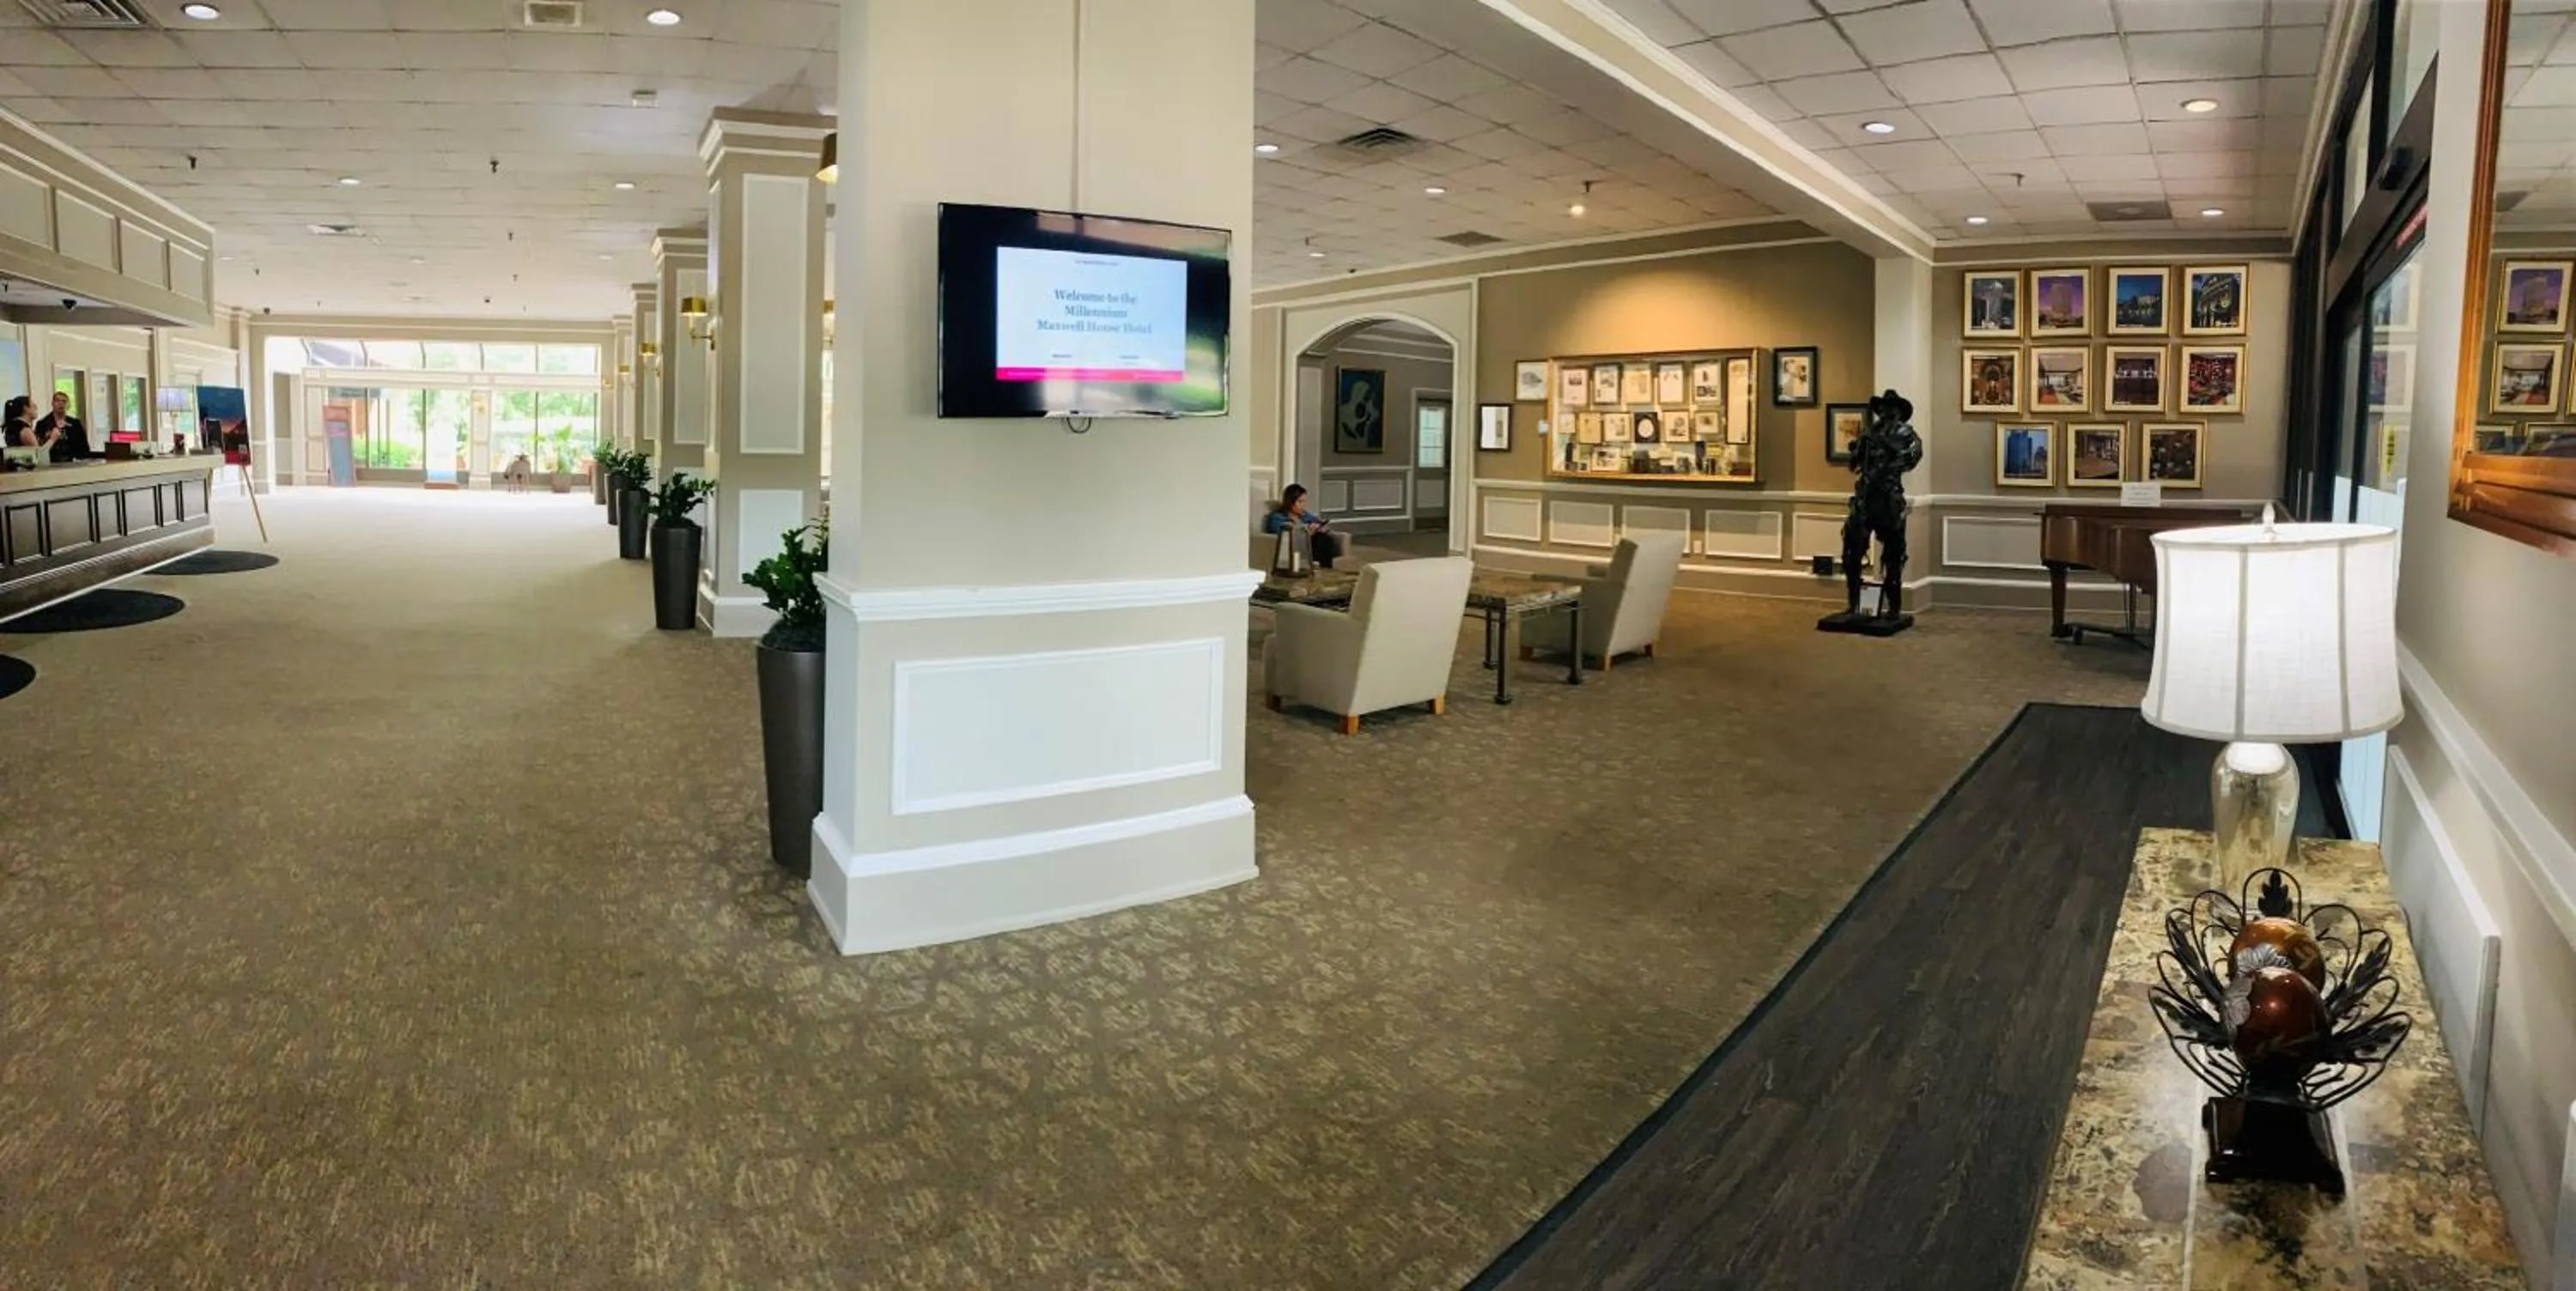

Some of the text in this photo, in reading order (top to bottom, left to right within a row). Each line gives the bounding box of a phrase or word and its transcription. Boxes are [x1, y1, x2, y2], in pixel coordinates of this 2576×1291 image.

[1054, 288, 1137, 304] Welcome to the
[1065, 305, 1127, 318] Millennium
[1036, 318, 1084, 331] Maxwell
[1086, 320, 1120, 332] House
